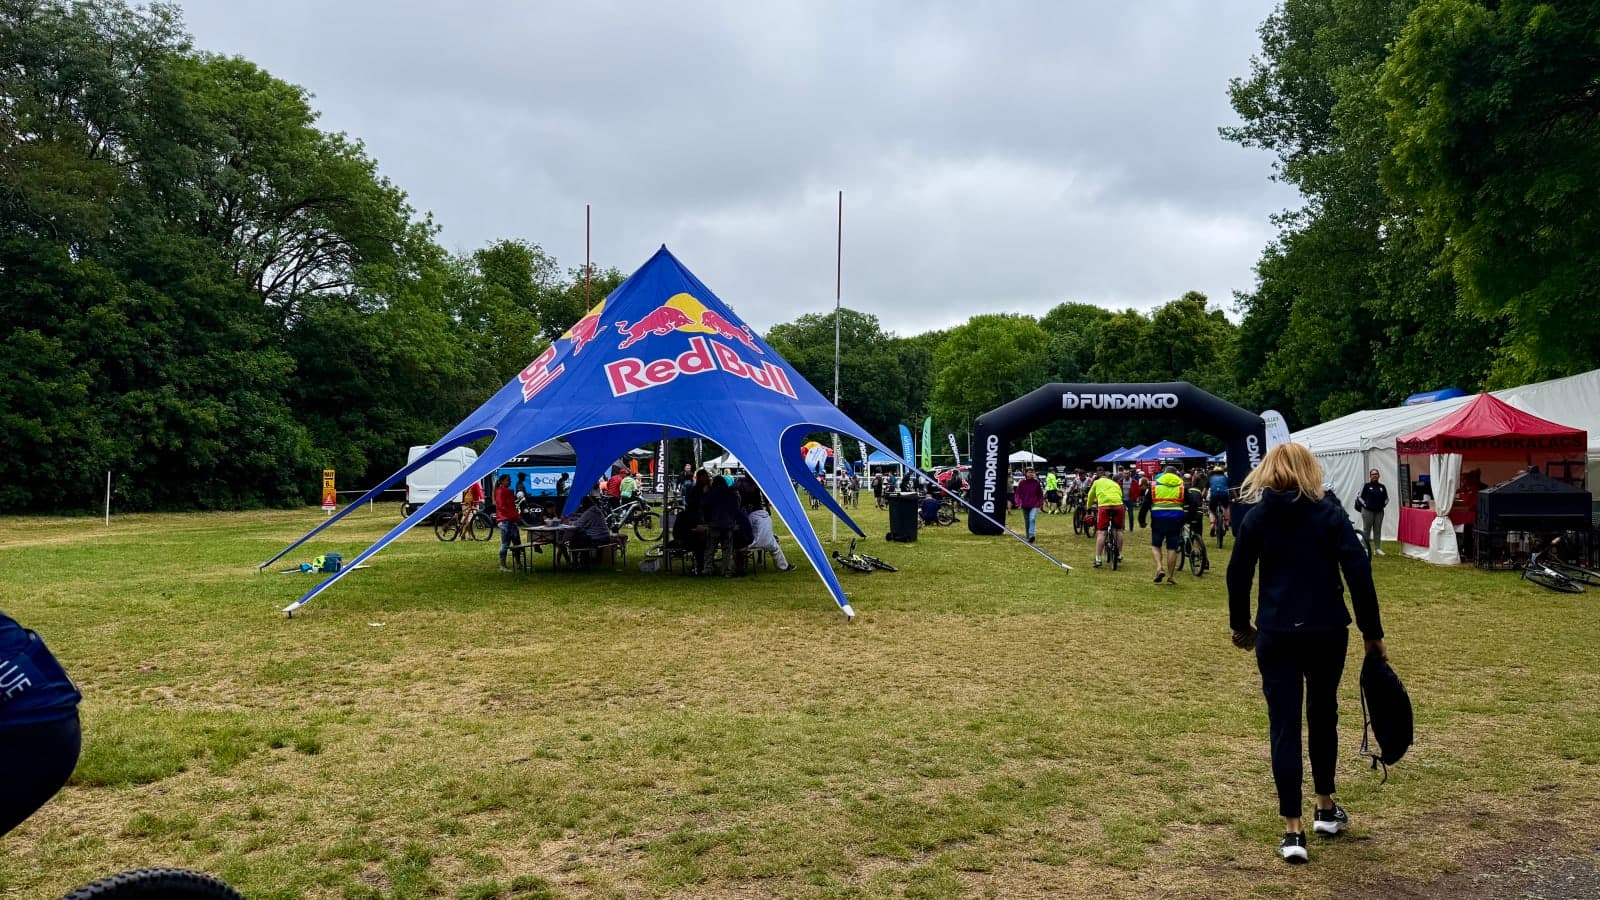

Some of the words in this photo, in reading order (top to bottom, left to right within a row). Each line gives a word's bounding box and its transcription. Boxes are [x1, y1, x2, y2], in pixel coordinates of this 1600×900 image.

[604, 336, 717, 397] Red
[709, 339, 799, 400] Bull
[1080, 393, 1179, 409] FUNDANGO
[983, 434, 999, 501] FUNDANGO
[0, 660, 32, 698] UE
